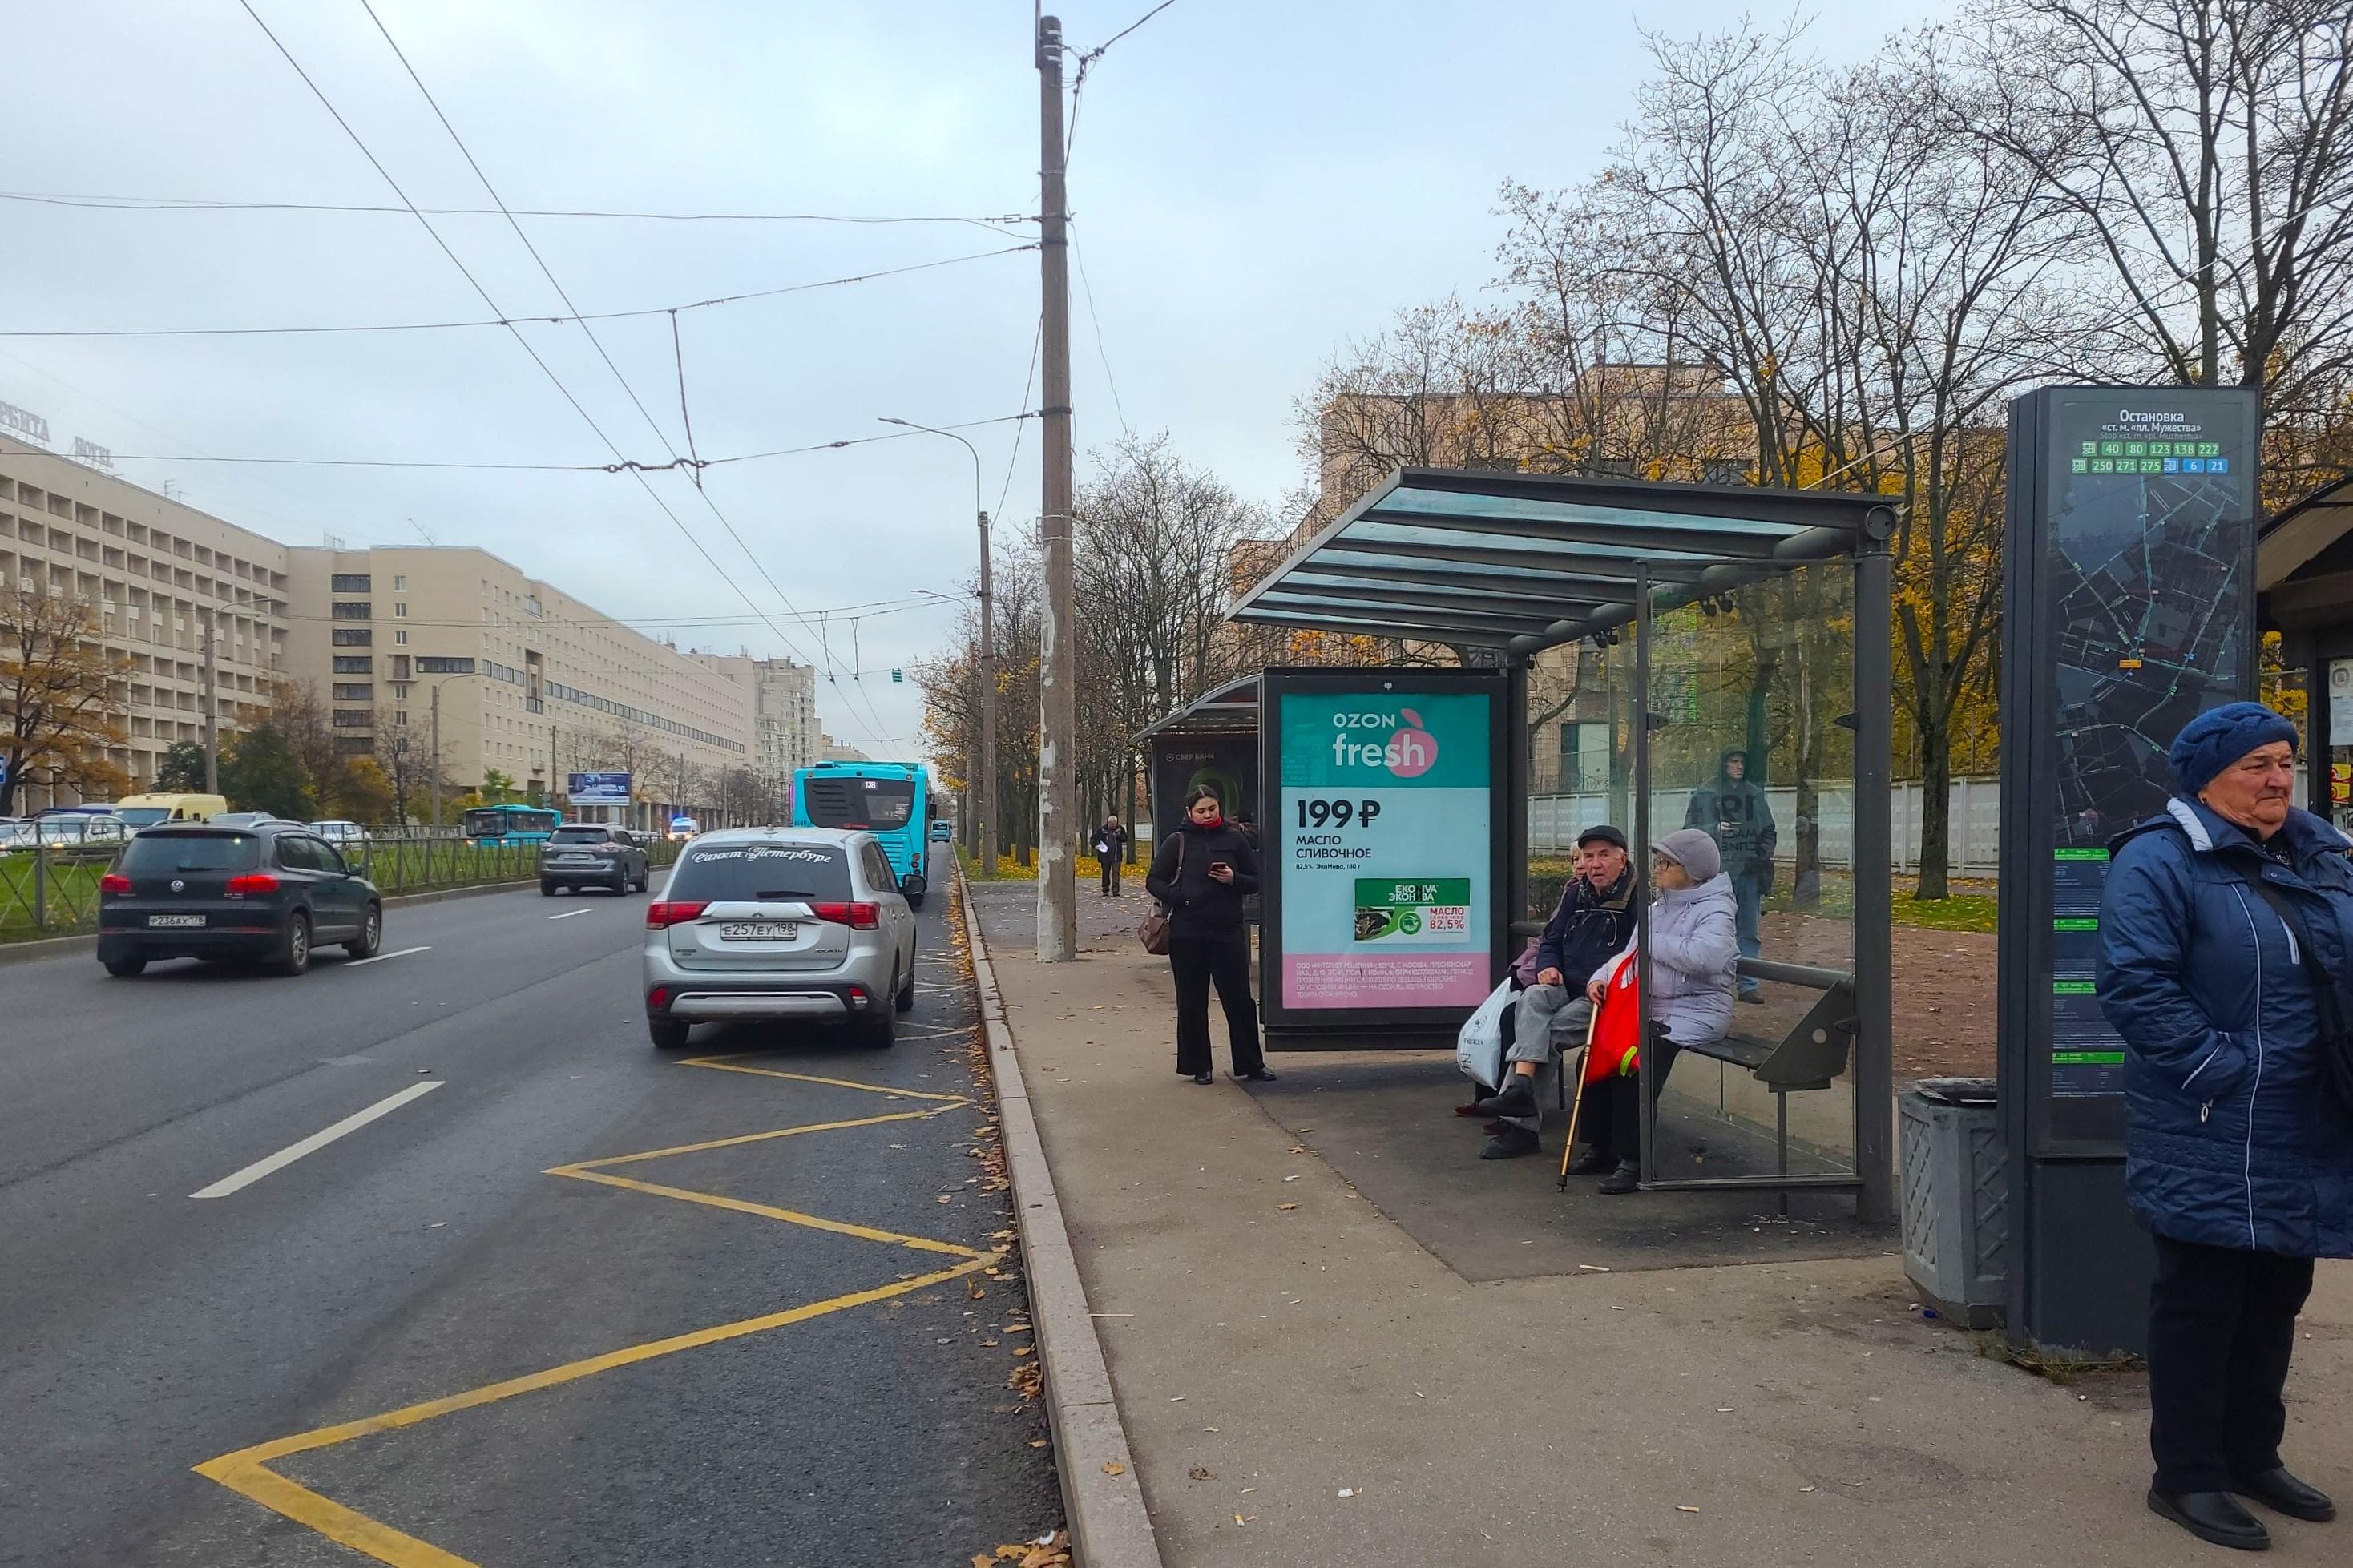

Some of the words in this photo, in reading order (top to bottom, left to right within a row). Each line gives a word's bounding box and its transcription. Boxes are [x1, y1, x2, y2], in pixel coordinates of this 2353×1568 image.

[2119, 409, 2185, 422] Остановка
[2101, 424, 2118, 433] «ст.
[2119, 425, 2129, 433] м.
[2131, 424, 2149, 433] «пл.
[2151, 423, 2202, 434] Мужества»
[2100, 432, 2117, 441] Stop
[2105, 445, 2119, 453] 40
[2129, 445, 2143, 453] 80
[2151, 445, 2170, 453] 123
[2174, 445, 2194, 453] 138
[2199, 445, 2218, 453] 222
[2093, 462, 2112, 470] 250
[2117, 462, 2136, 470] 271
[2141, 462, 2161, 470] 275
[2190, 462, 2197, 470] 6
[2212, 462, 2224, 470] 21
[1333, 713, 1395, 728] OZON
[1332, 733, 1425, 767] fresh
[1297, 800, 1354, 828] 199
[1296, 836, 1342, 845] МАСЛО
[692, 846, 833, 863] Санкт-Петербург
[1296, 848, 1371, 859] СЛИВОЧНОЕ
[1430, 907, 1464, 915] МАСЛО
[724, 923, 773, 936] Е257ЕУ
[775, 922, 793, 932] 198
[1430, 920, 1465, 930] 82,5%
